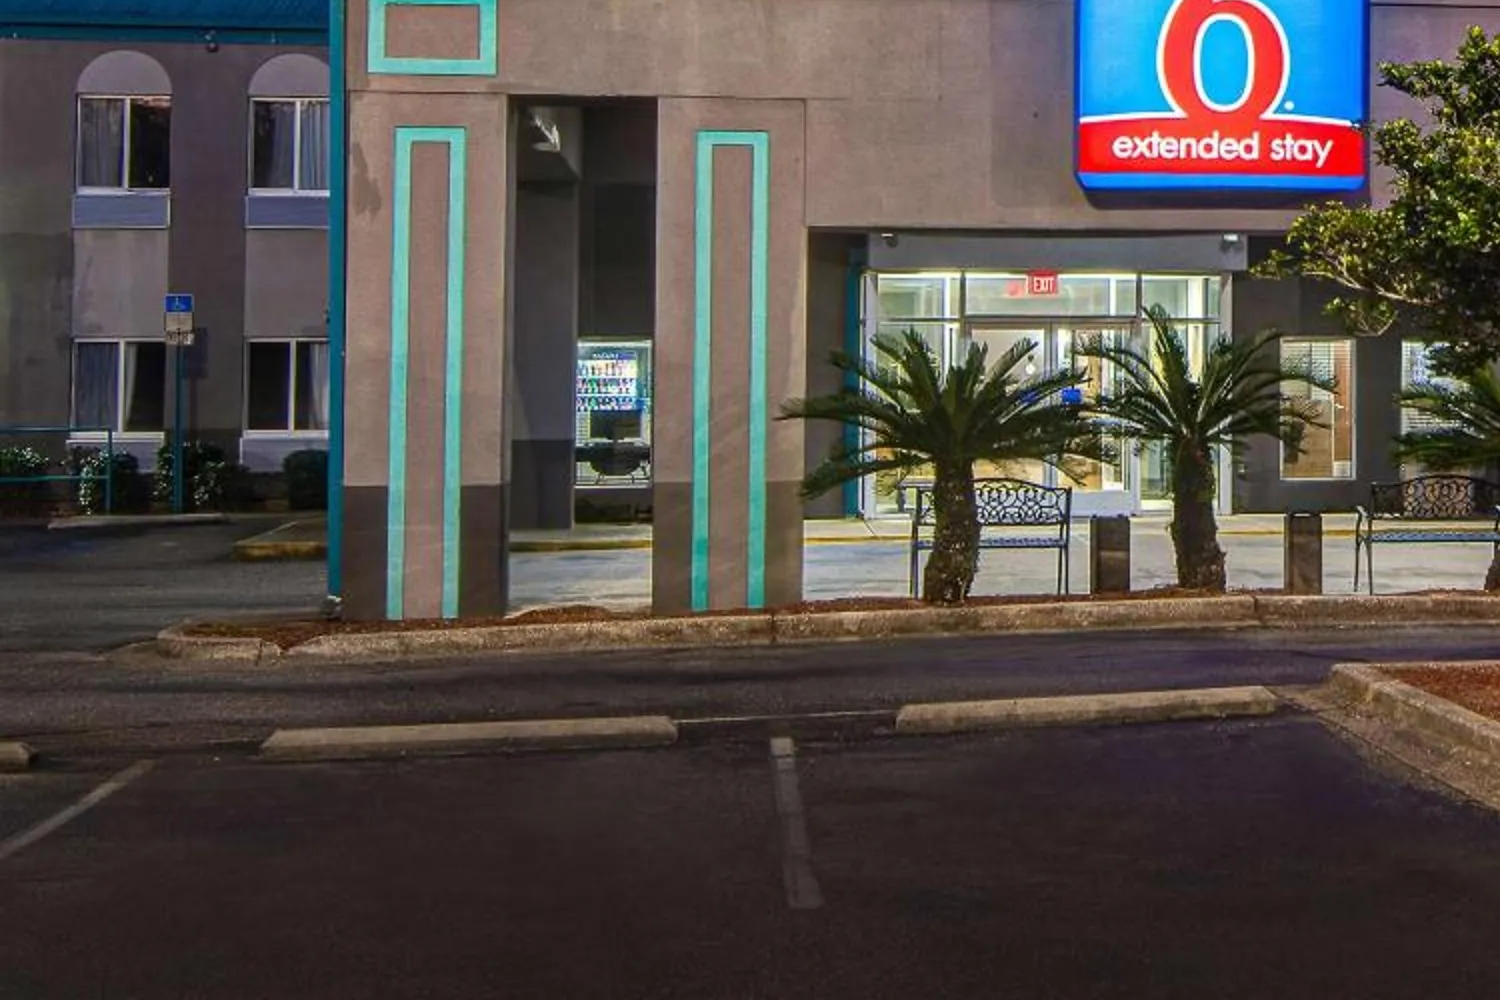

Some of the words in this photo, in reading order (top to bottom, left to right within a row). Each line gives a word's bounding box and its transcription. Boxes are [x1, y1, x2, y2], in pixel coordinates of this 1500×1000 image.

[1112, 130, 1259, 160] extended
[1270, 133, 1333, 168] stay
[1033, 276, 1054, 293] EXIT
